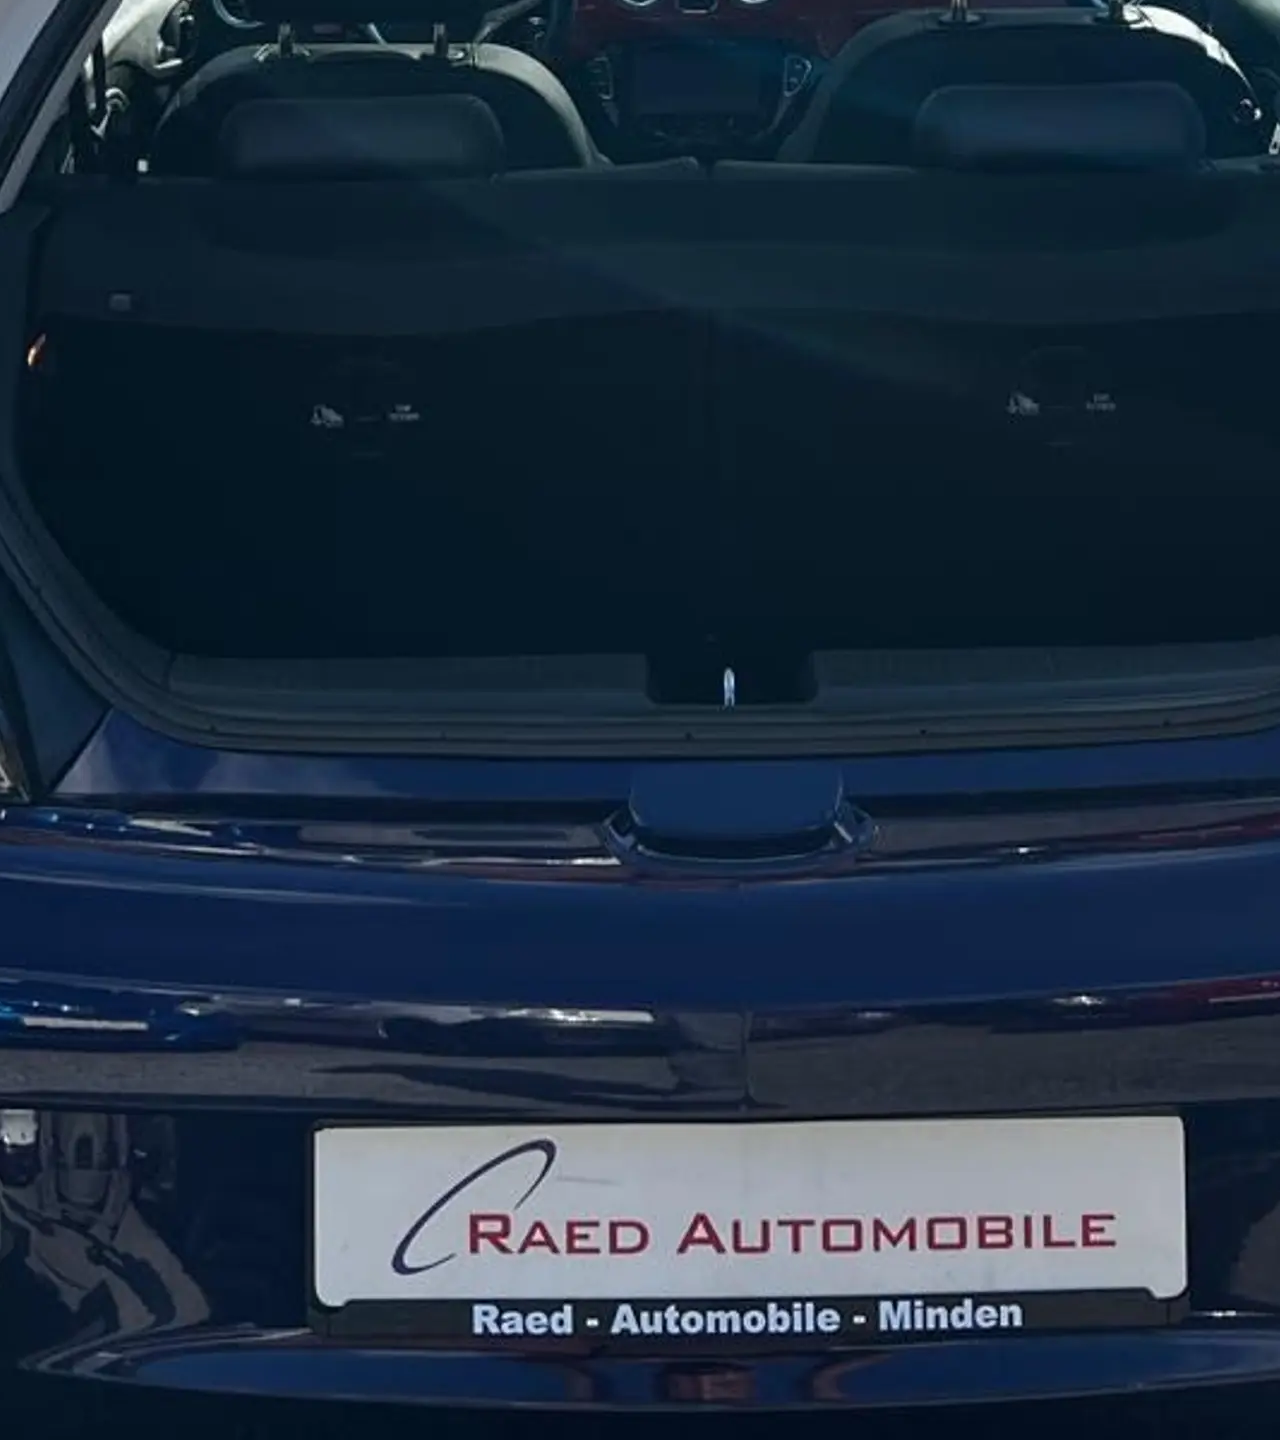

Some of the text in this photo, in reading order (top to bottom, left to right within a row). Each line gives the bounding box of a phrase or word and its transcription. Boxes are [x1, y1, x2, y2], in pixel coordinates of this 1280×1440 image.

[469, 1212, 1117, 1255] RAED AUTOMOBILE
[472, 1303, 574, 1335] Raed
[610, 1301, 841, 1335] Automobile
[878, 1297, 1023, 1331] Minden
